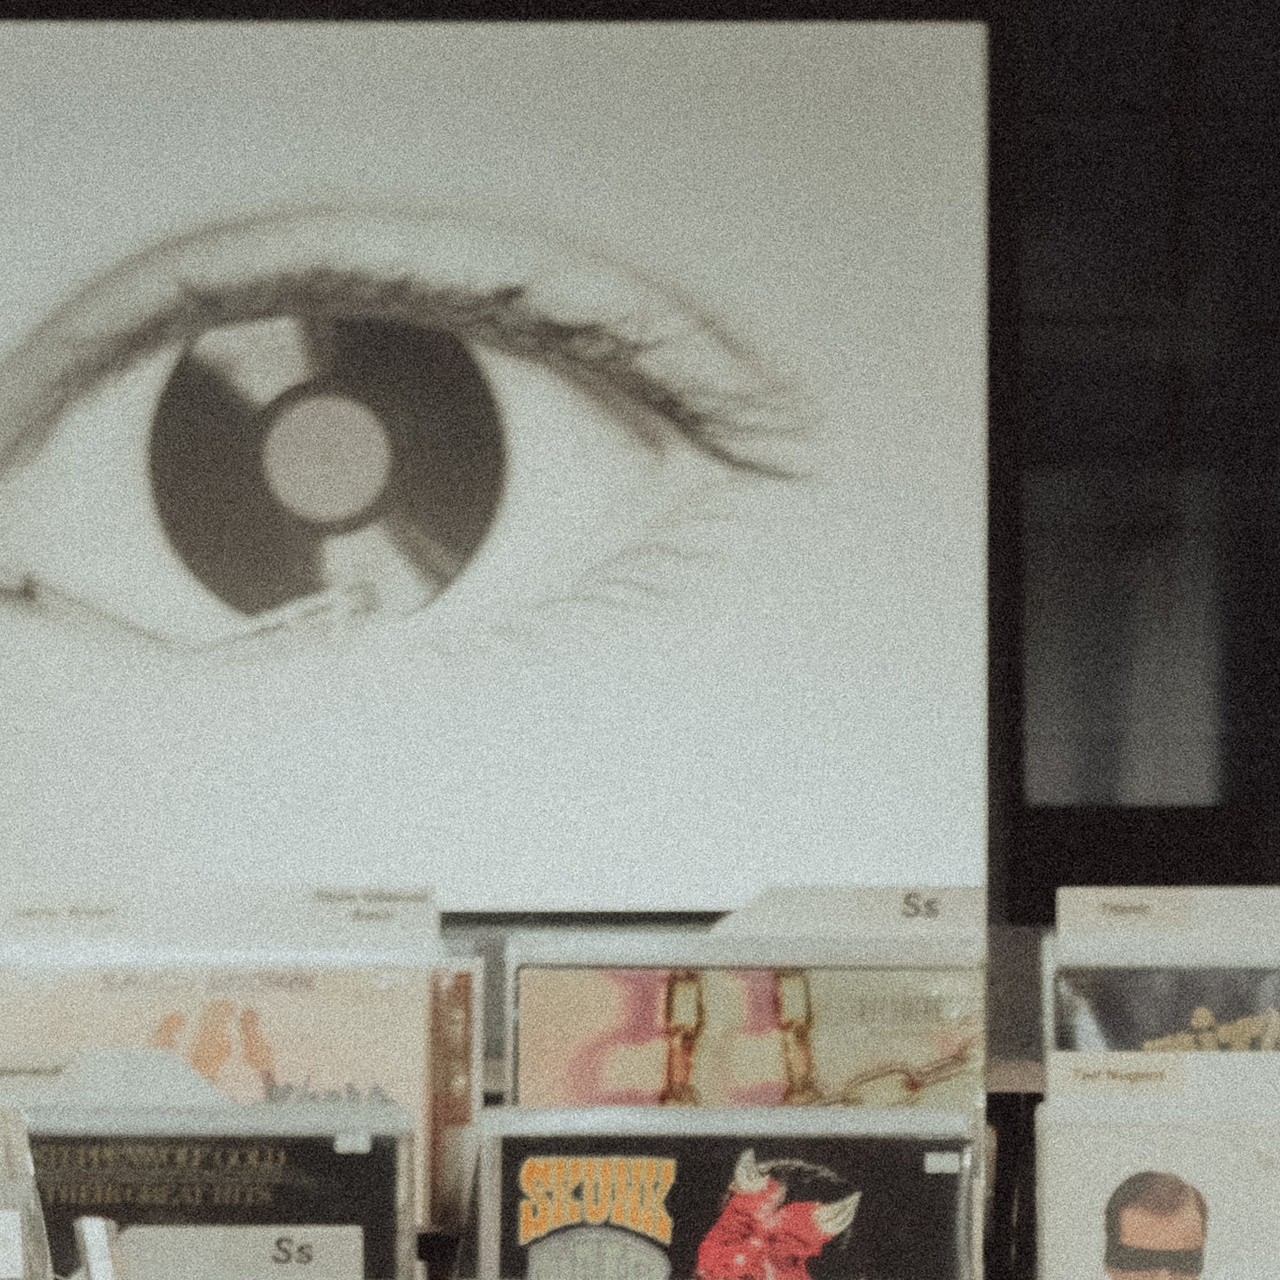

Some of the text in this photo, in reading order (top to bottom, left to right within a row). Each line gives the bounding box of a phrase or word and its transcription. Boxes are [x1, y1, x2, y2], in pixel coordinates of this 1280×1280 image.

[902, 891, 940, 919] Ss
[518, 1156, 677, 1246] SKUNK
[271, 1236, 314, 1265] Ss
